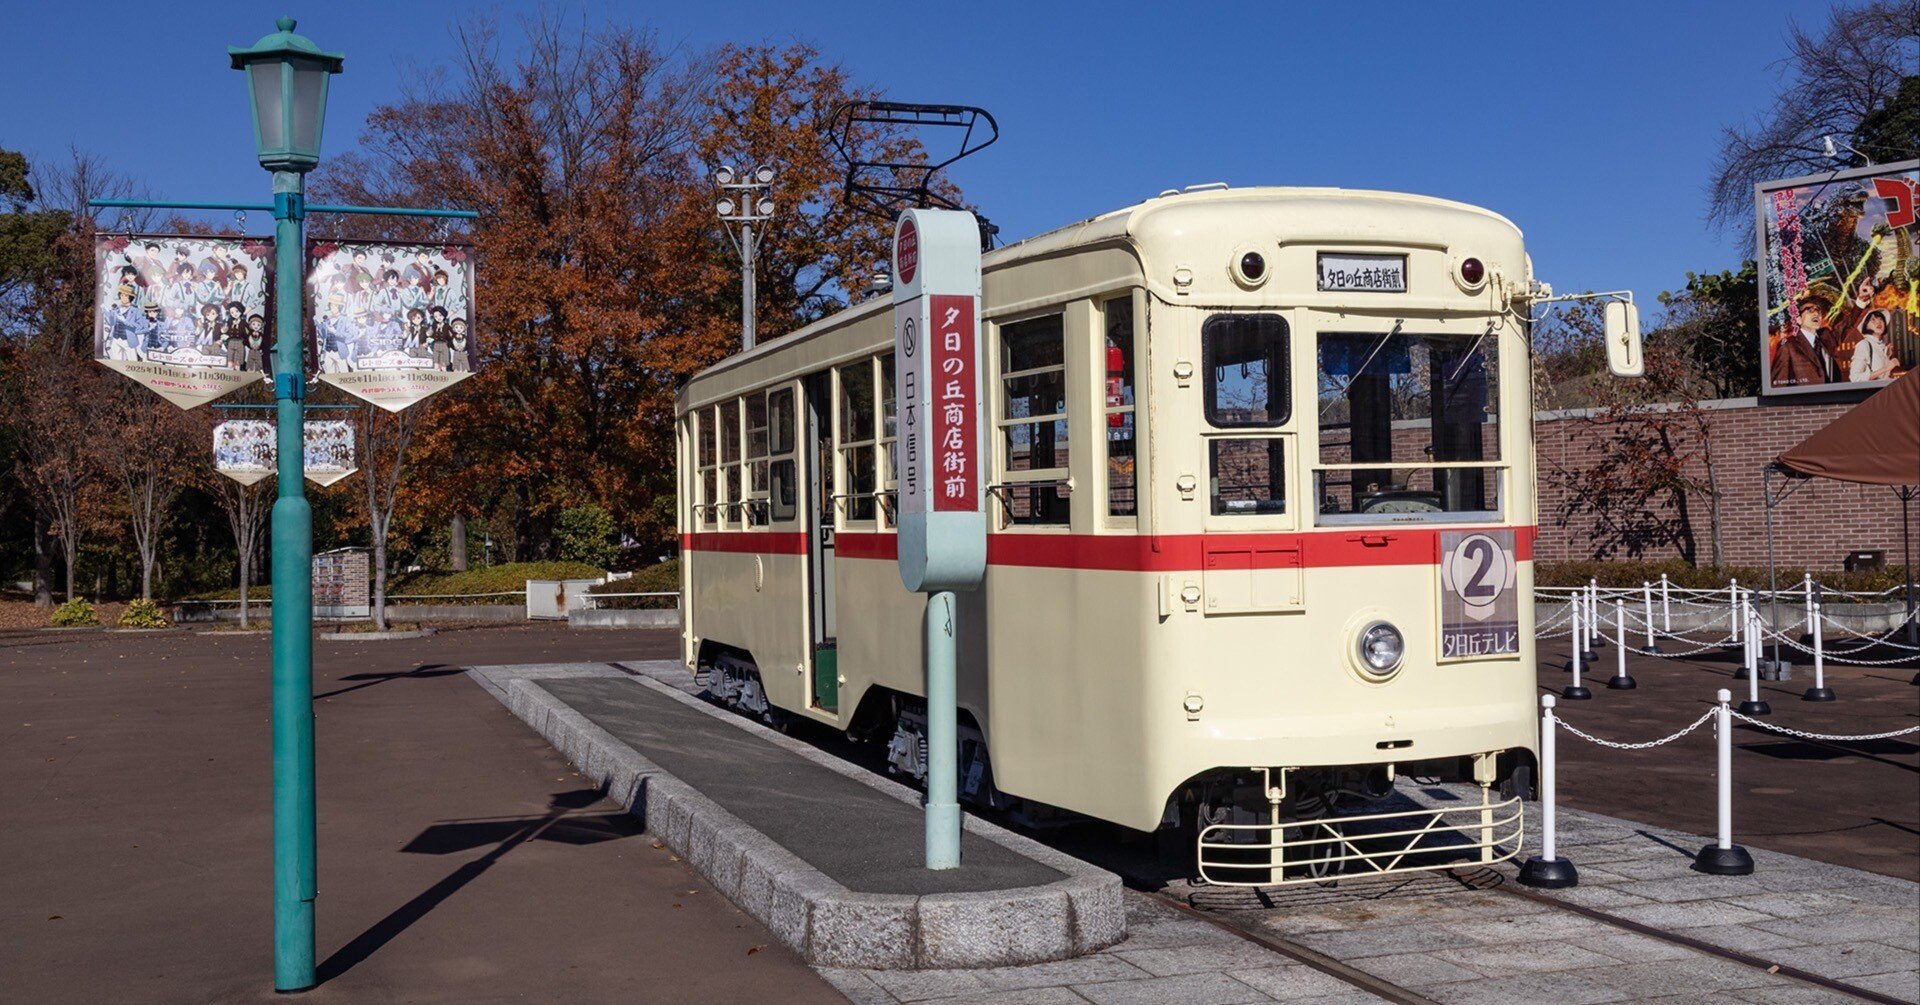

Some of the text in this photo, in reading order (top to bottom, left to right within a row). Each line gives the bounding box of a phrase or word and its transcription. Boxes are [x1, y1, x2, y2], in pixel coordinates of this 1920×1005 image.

[1872, 177, 1920, 230] ゴ
[1328, 267, 1401, 289] 夕日の丘商店街前
[941, 307, 966, 499] 夕日の丘商店街前
[906, 371, 916, 495] 日本信号
[1463, 539, 1495, 597] 2
[1444, 631, 1518, 656] 夕日丘テレビ
